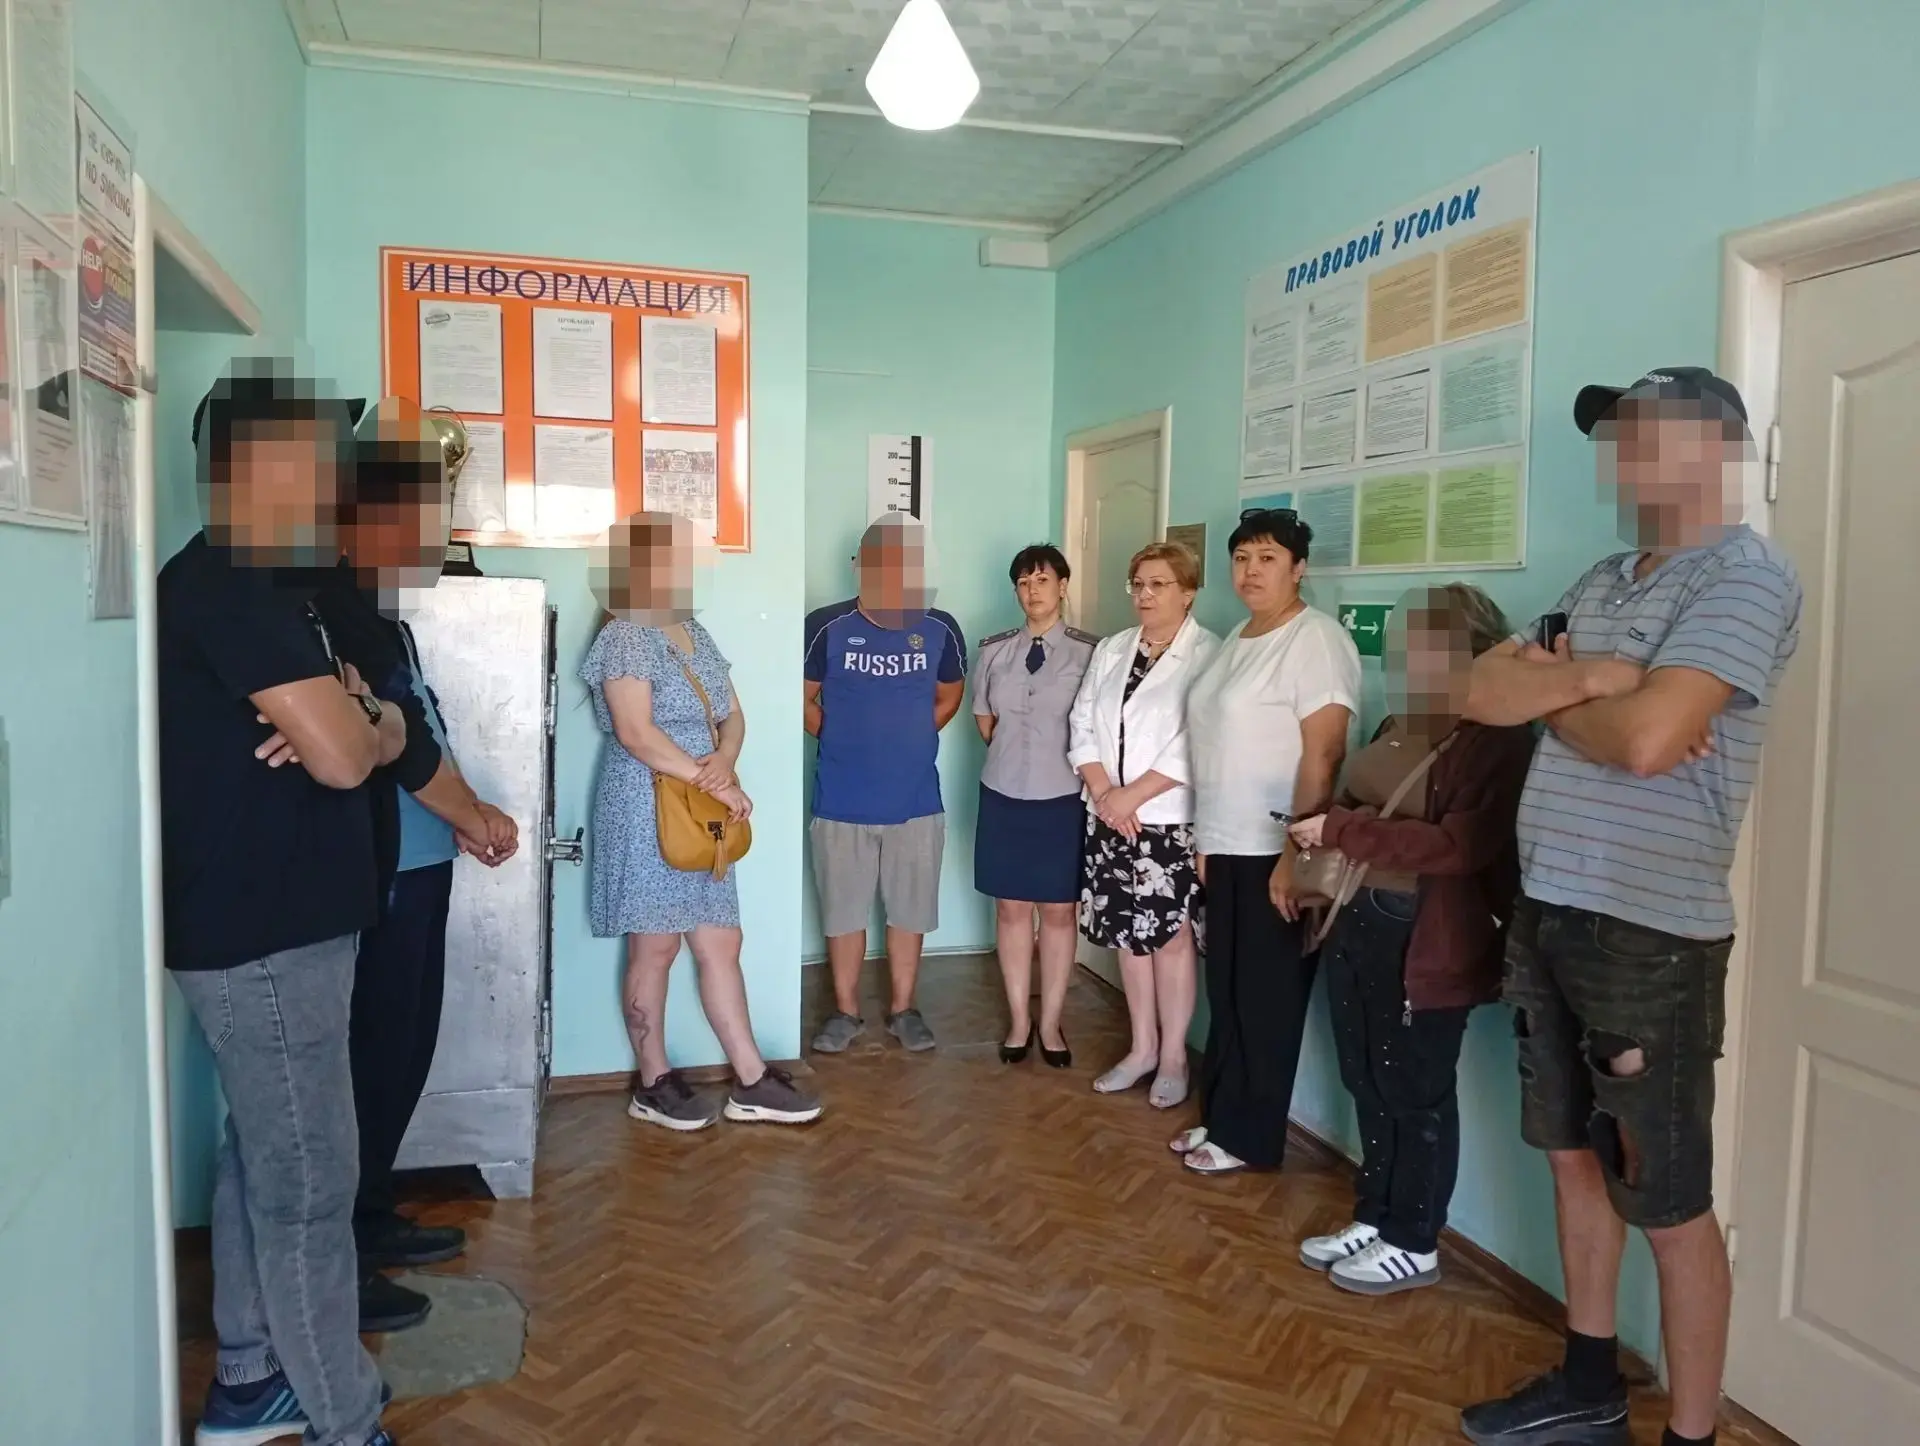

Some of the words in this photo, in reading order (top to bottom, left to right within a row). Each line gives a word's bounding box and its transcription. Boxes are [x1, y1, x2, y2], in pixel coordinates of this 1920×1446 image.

[85, 158, 97, 184] NO
[100, 172, 131, 217] SMOKING
[1285, 220, 1384, 293] ПРАВОВОЙ
[1392, 185, 1480, 250] УГОЛОК
[407, 261, 729, 316] ИНФОРМАЦИЯ
[844, 651, 927, 676] RUSSIA
